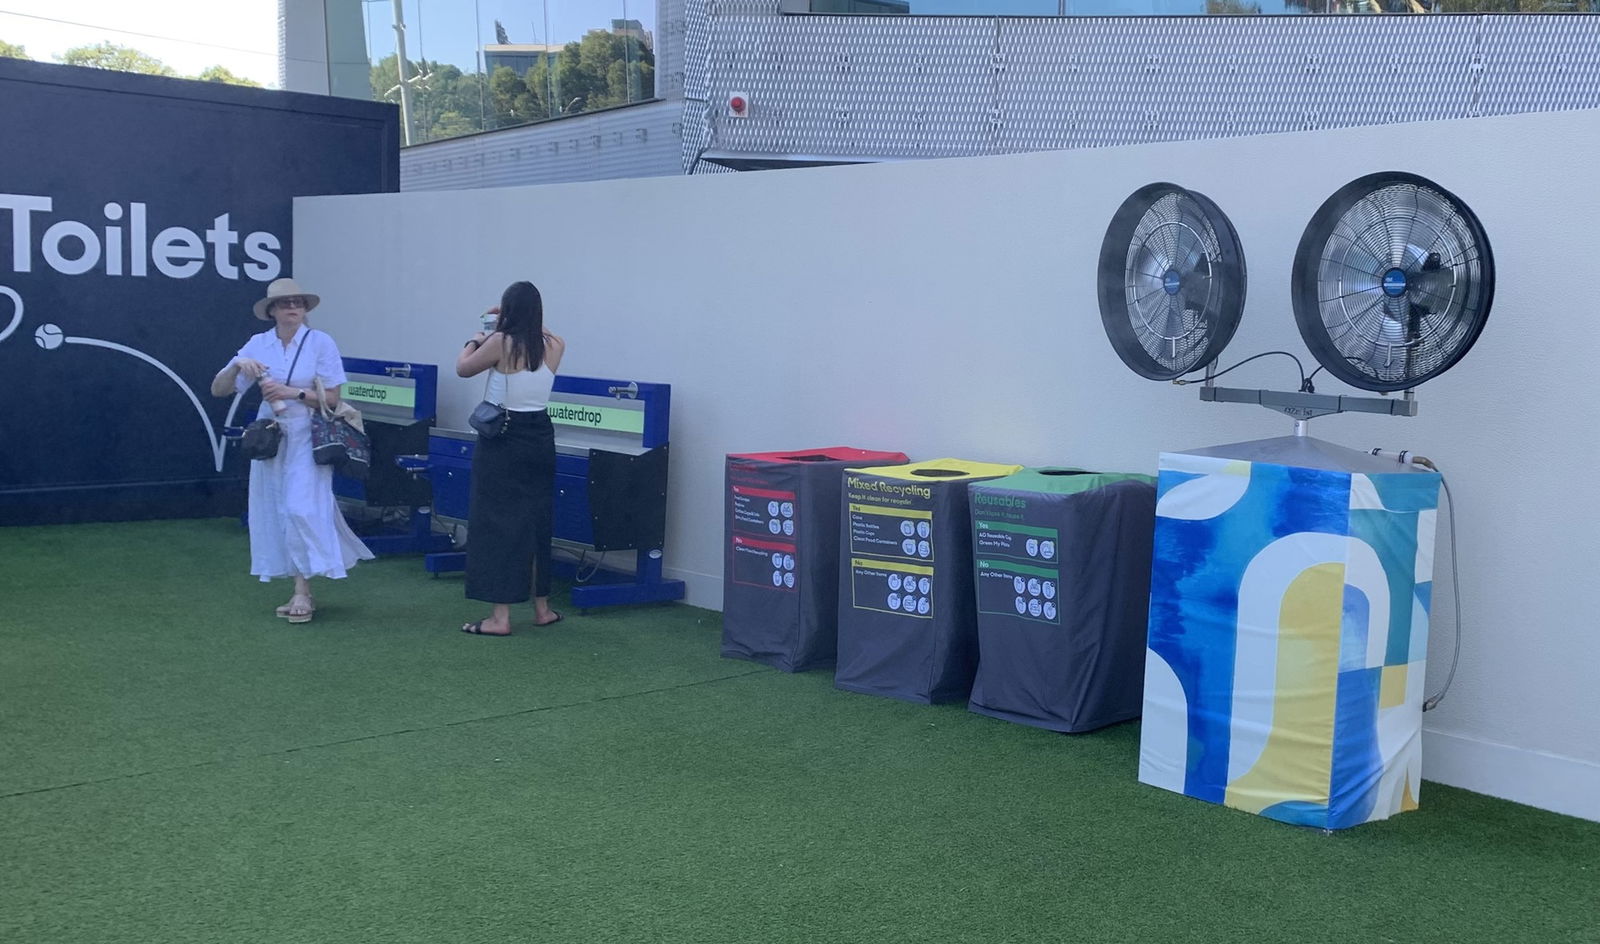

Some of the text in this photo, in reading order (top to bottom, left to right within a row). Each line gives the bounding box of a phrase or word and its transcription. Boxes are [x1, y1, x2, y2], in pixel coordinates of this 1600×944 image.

[0, 193, 281, 282] Toilets
[348, 385, 387, 401] waterdrop
[549, 406, 602, 426] waterdrop
[847, 476, 931, 499] Mixed Recycling
[848, 492, 860, 501] Keep
[974, 492, 1026, 509] Reusables
[980, 560, 990, 568] No
